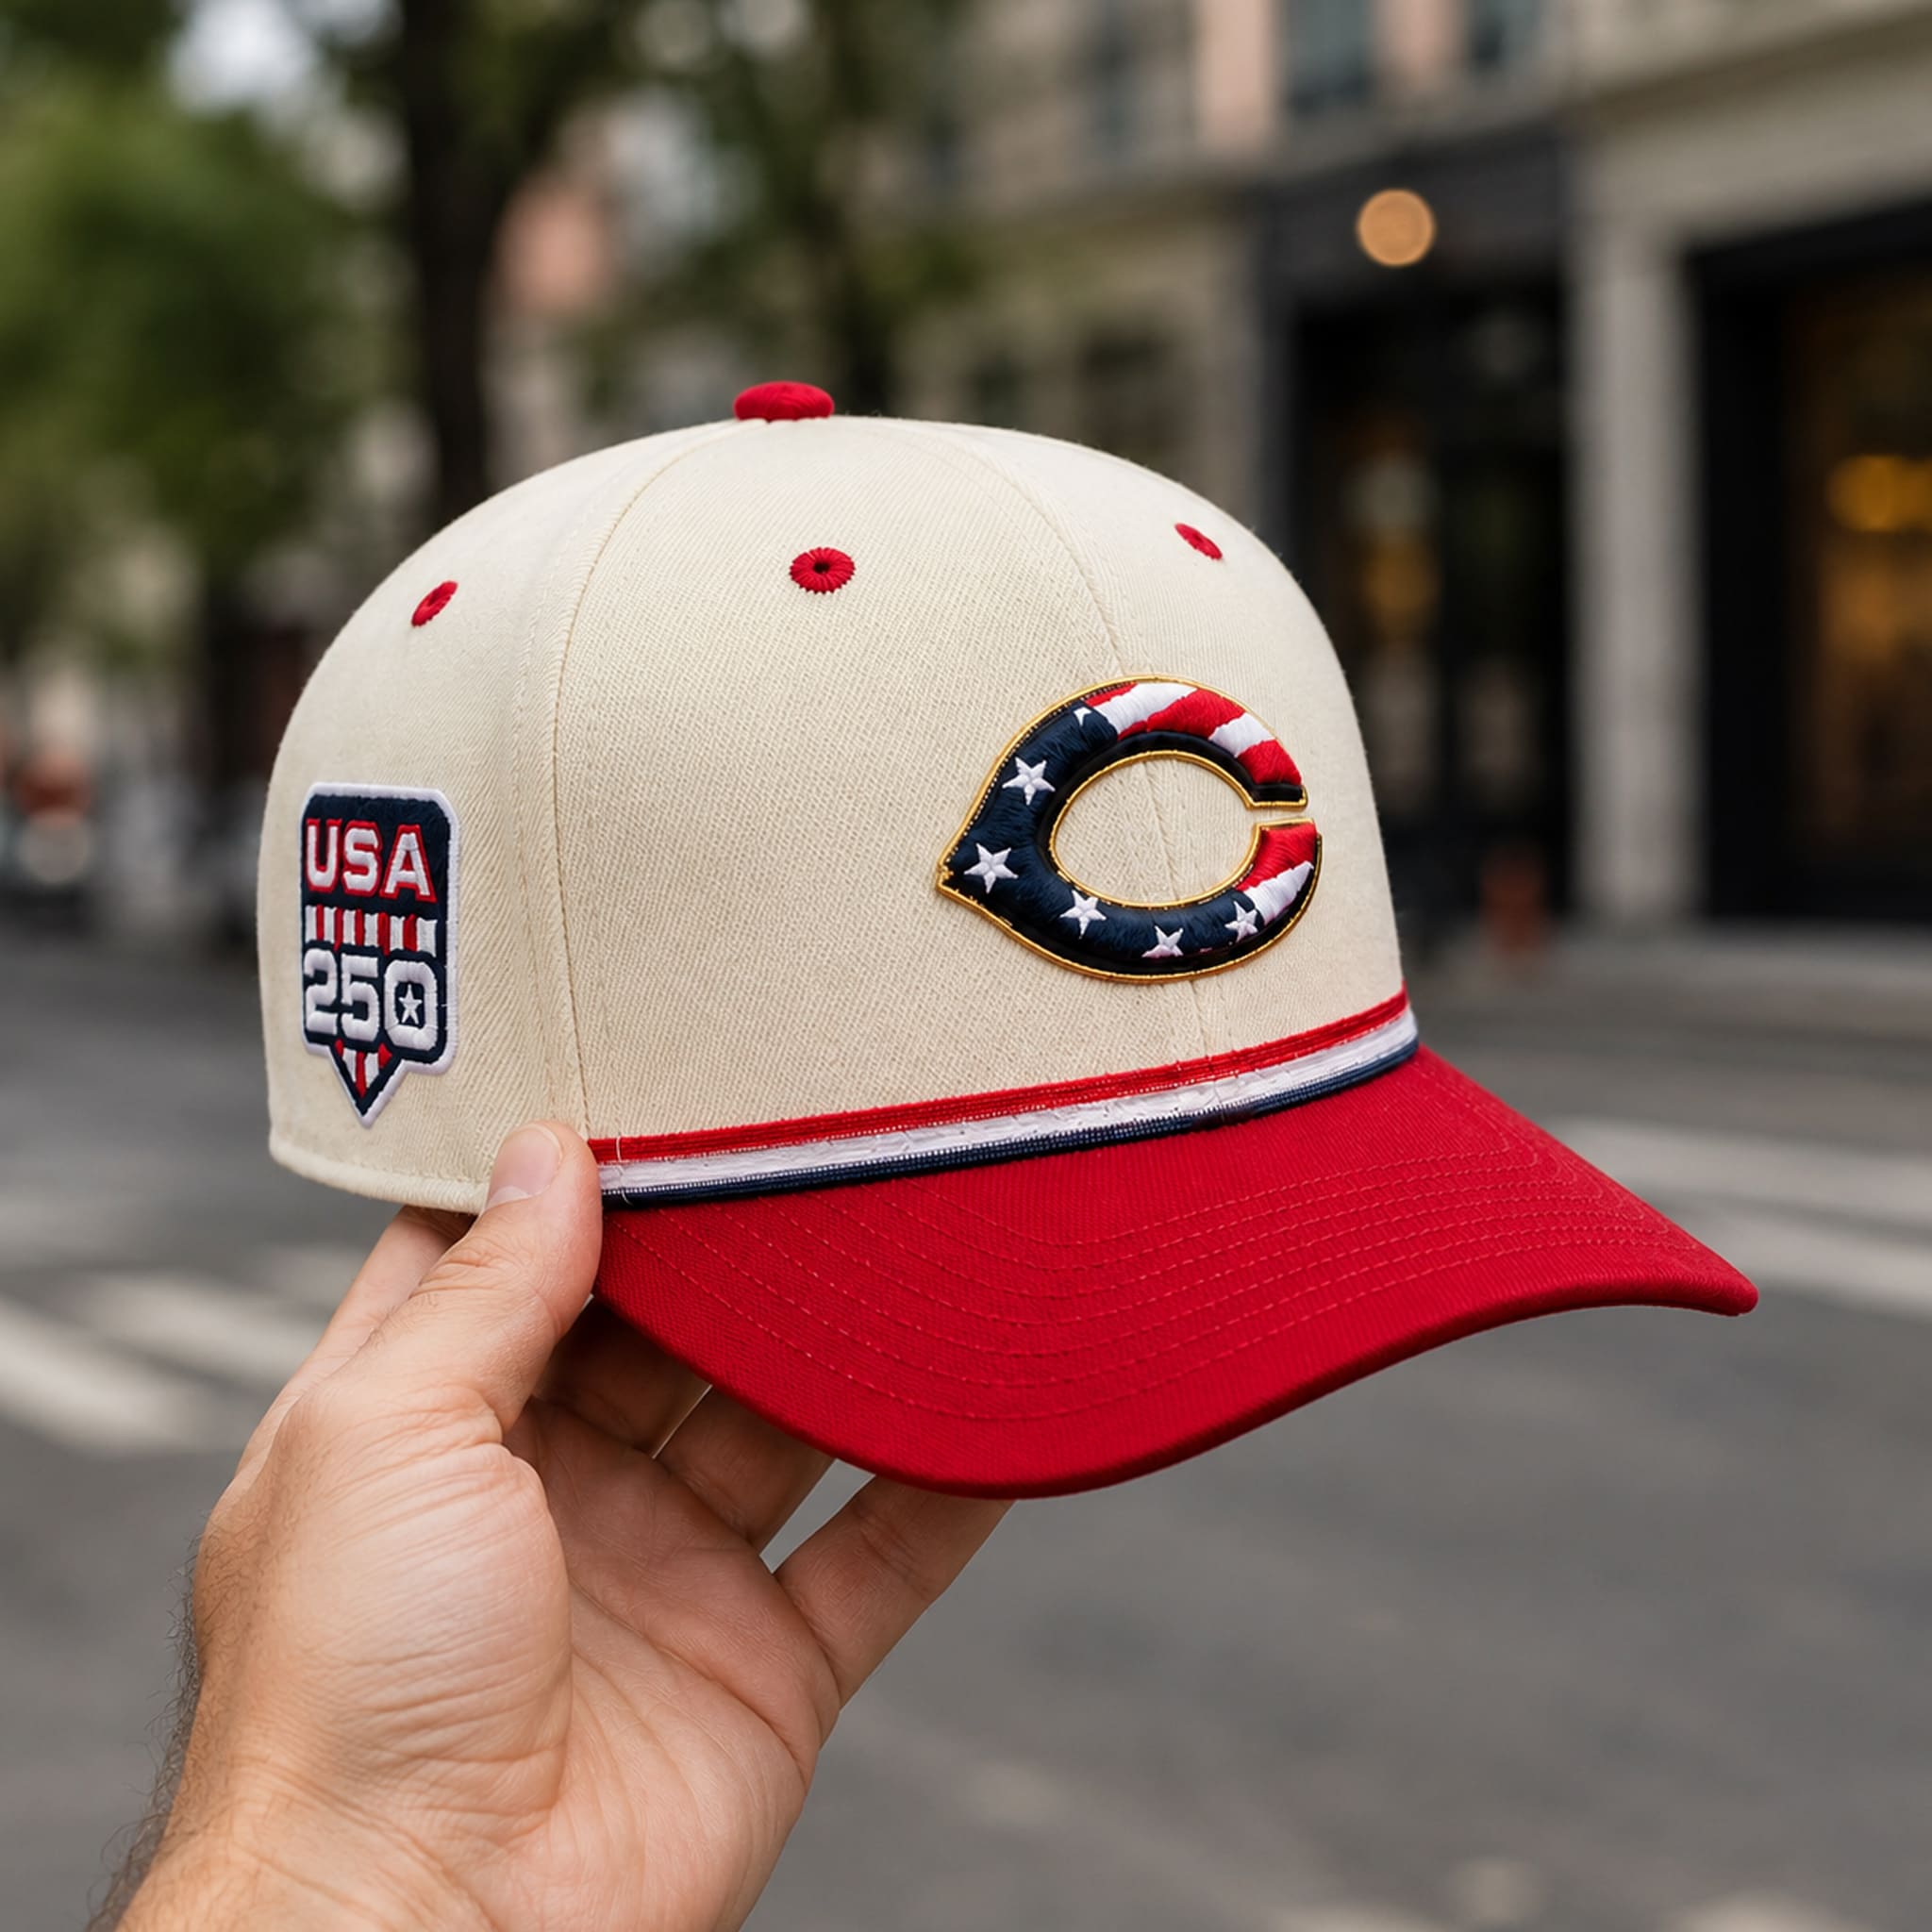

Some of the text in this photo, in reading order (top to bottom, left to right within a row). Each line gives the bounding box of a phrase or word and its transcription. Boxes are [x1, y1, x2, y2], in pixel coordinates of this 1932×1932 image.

[306, 819, 437, 902] USA
[936, 675, 1322, 984] C
[304, 948, 438, 1051] 250
